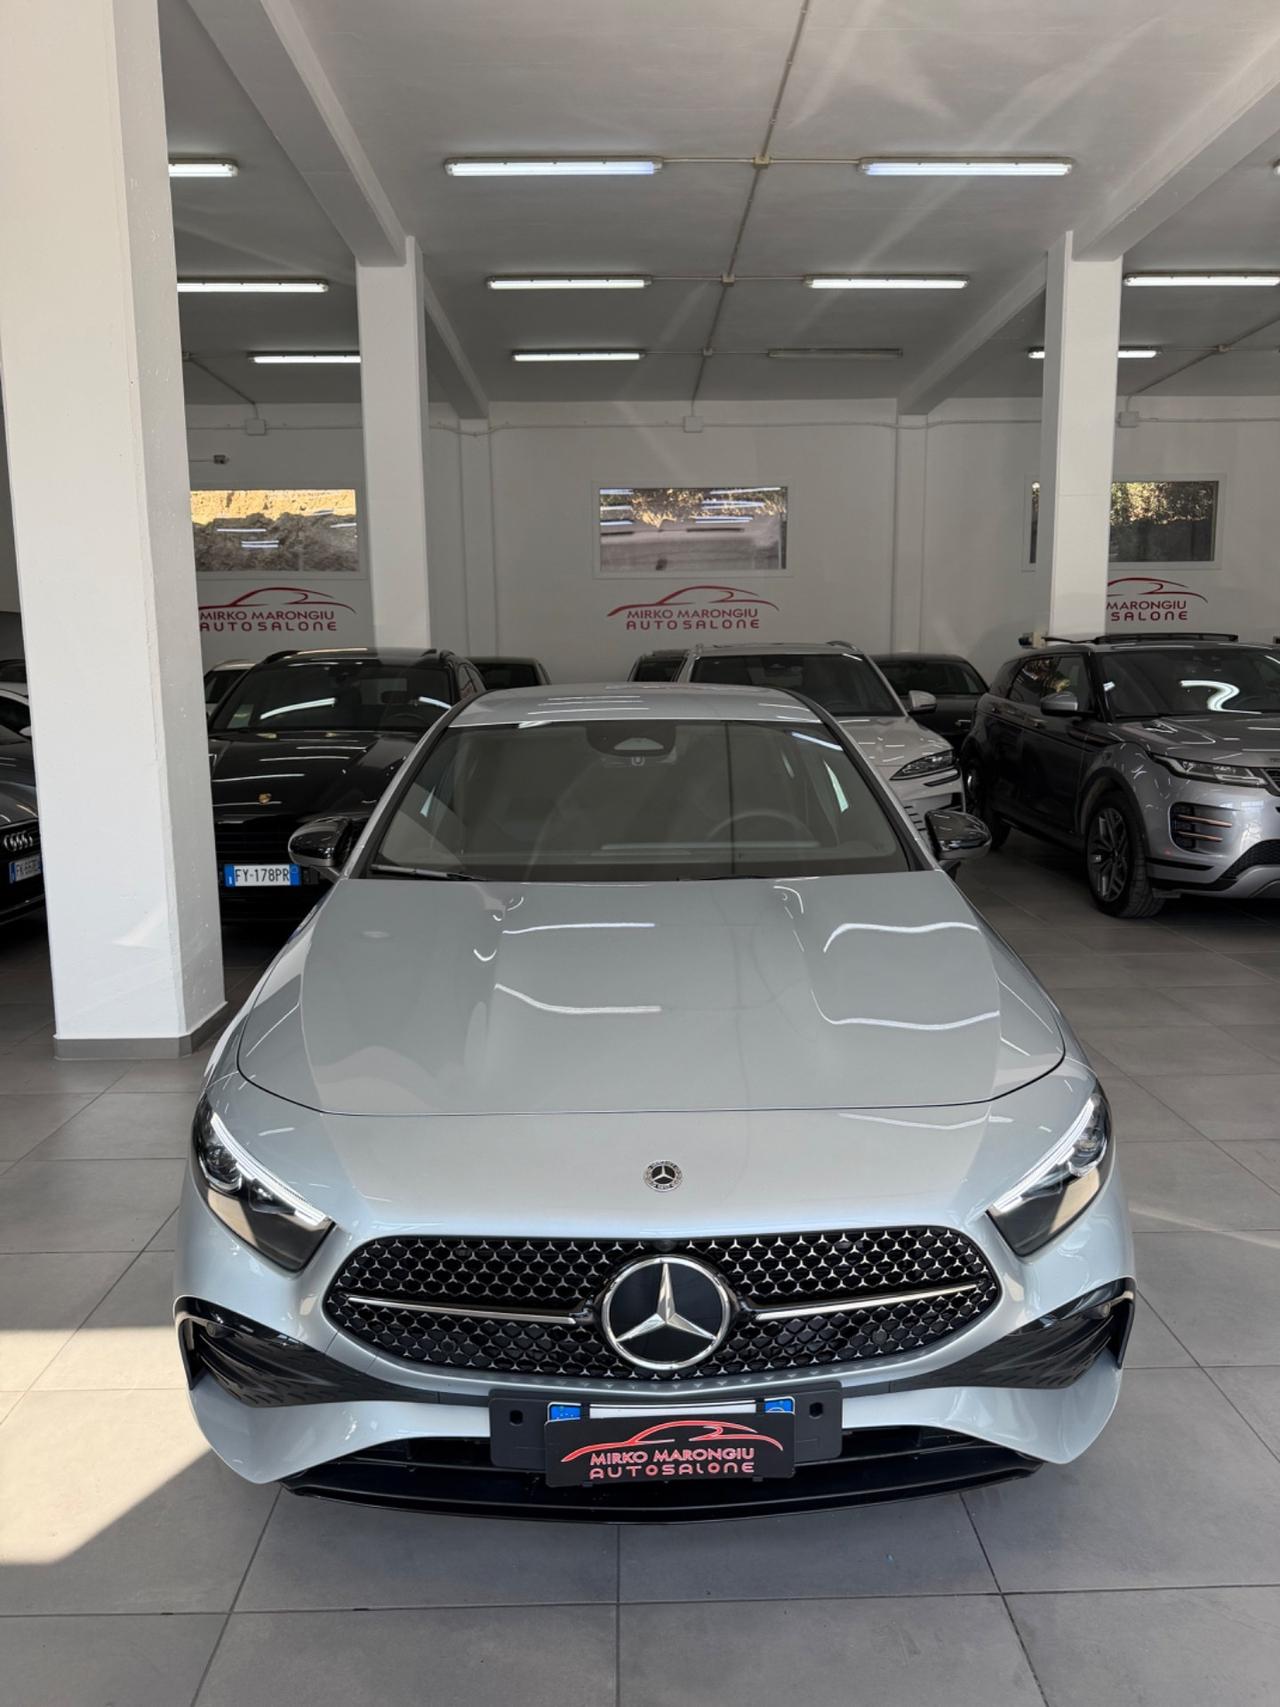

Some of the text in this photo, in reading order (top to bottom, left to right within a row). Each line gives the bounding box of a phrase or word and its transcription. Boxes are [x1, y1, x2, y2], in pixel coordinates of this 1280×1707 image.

[1106, 600, 1187, 611] MARONGIU
[200, 610, 335, 621] MIRKO MARONGIU
[627, 608, 758, 619] MIRKO MARONGIU
[1110, 611, 1188, 622] SALONE
[200, 621, 338, 632] AUTOSALONE
[626, 619, 760, 631] AUTOSALONE
[590, 1447, 755, 1466] MIRKO MARONGIU
[590, 1461, 755, 1480] AUTOSALONE
